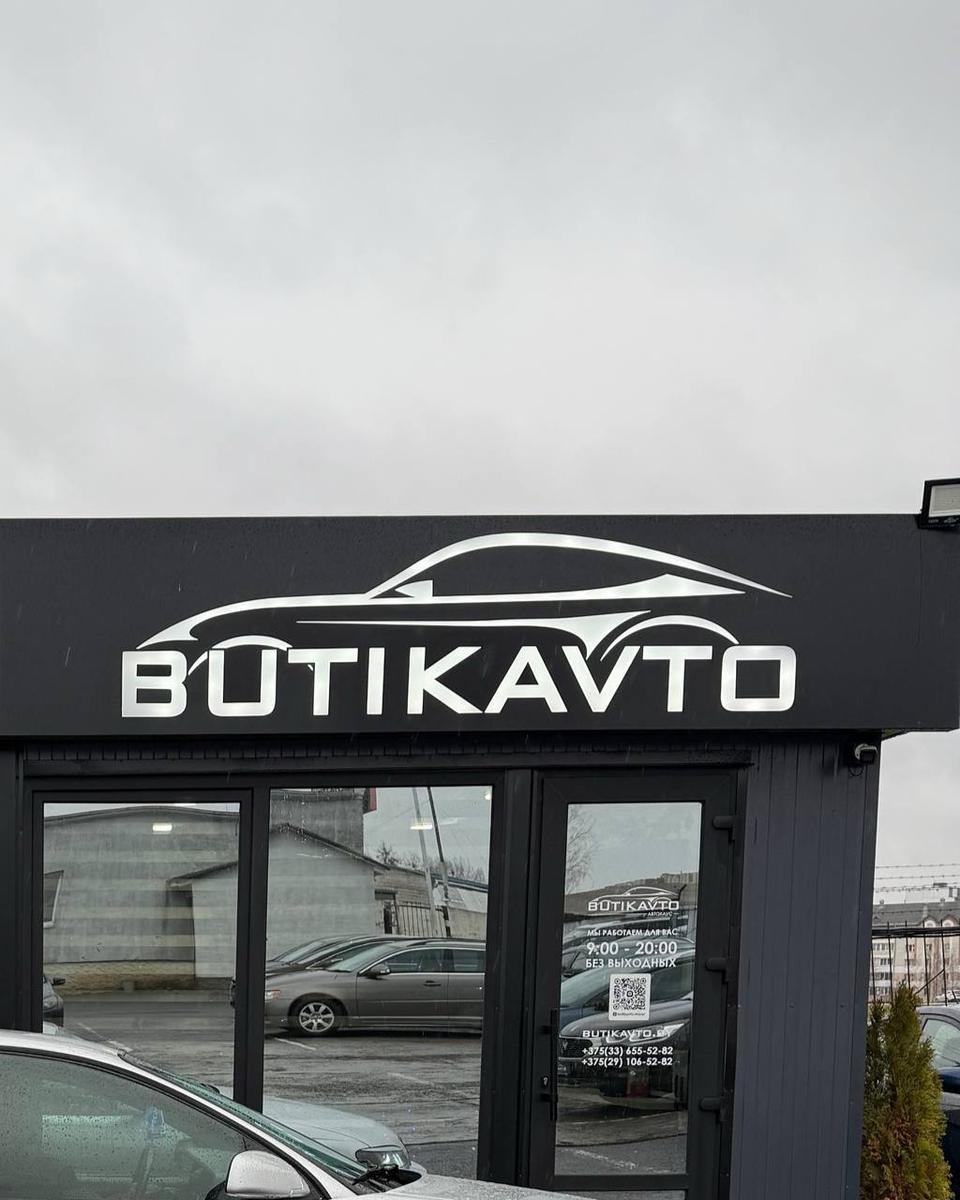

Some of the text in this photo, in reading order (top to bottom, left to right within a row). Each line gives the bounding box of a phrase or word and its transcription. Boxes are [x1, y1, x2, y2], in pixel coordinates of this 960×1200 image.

[122, 645, 796, 717] BUTIKAVTO
[588, 900, 679, 911] BUTIKAVTO
[644, 928, 660, 936] ДЛЯ
[662, 928, 678, 936] ВАС
[586, 941, 619, 955] 9:00
[635, 941, 678, 955] 20:00
[585, 957, 676, 969] БЕЗ ВЫХОДНЫХ
[582, 1046, 673, 1056] +375(33) 655-52-82
[581, 1057, 673, 1068] +375(29) 106-52-82
